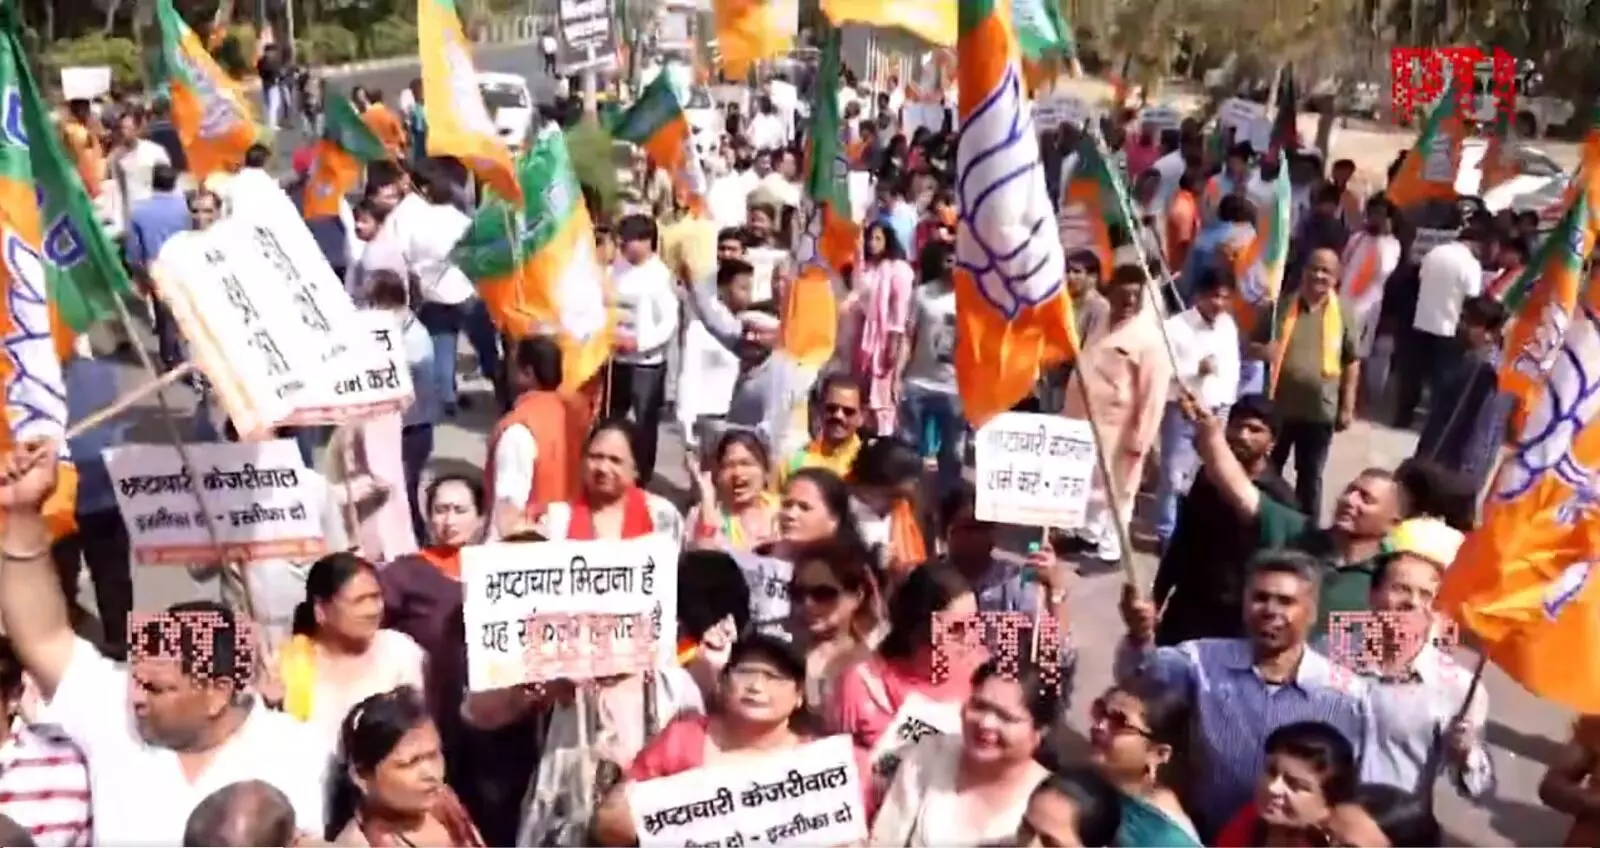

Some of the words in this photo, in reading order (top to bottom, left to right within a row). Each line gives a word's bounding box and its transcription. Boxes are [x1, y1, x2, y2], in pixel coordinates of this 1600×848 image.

[203, 462, 299, 490] केजरीवाल
[486, 569, 564, 605] भ्रष्टाचार
[570, 555, 633, 596] मिटाना
[641, 555, 655, 595] है
[481, 620, 509, 652] यह
[643, 787, 734, 835] भ्रष्टाचारी
[741, 762, 848, 808] केजरीवाल
[765, 810, 829, 844] इस्तीफा
[835, 802, 853, 825] दो
